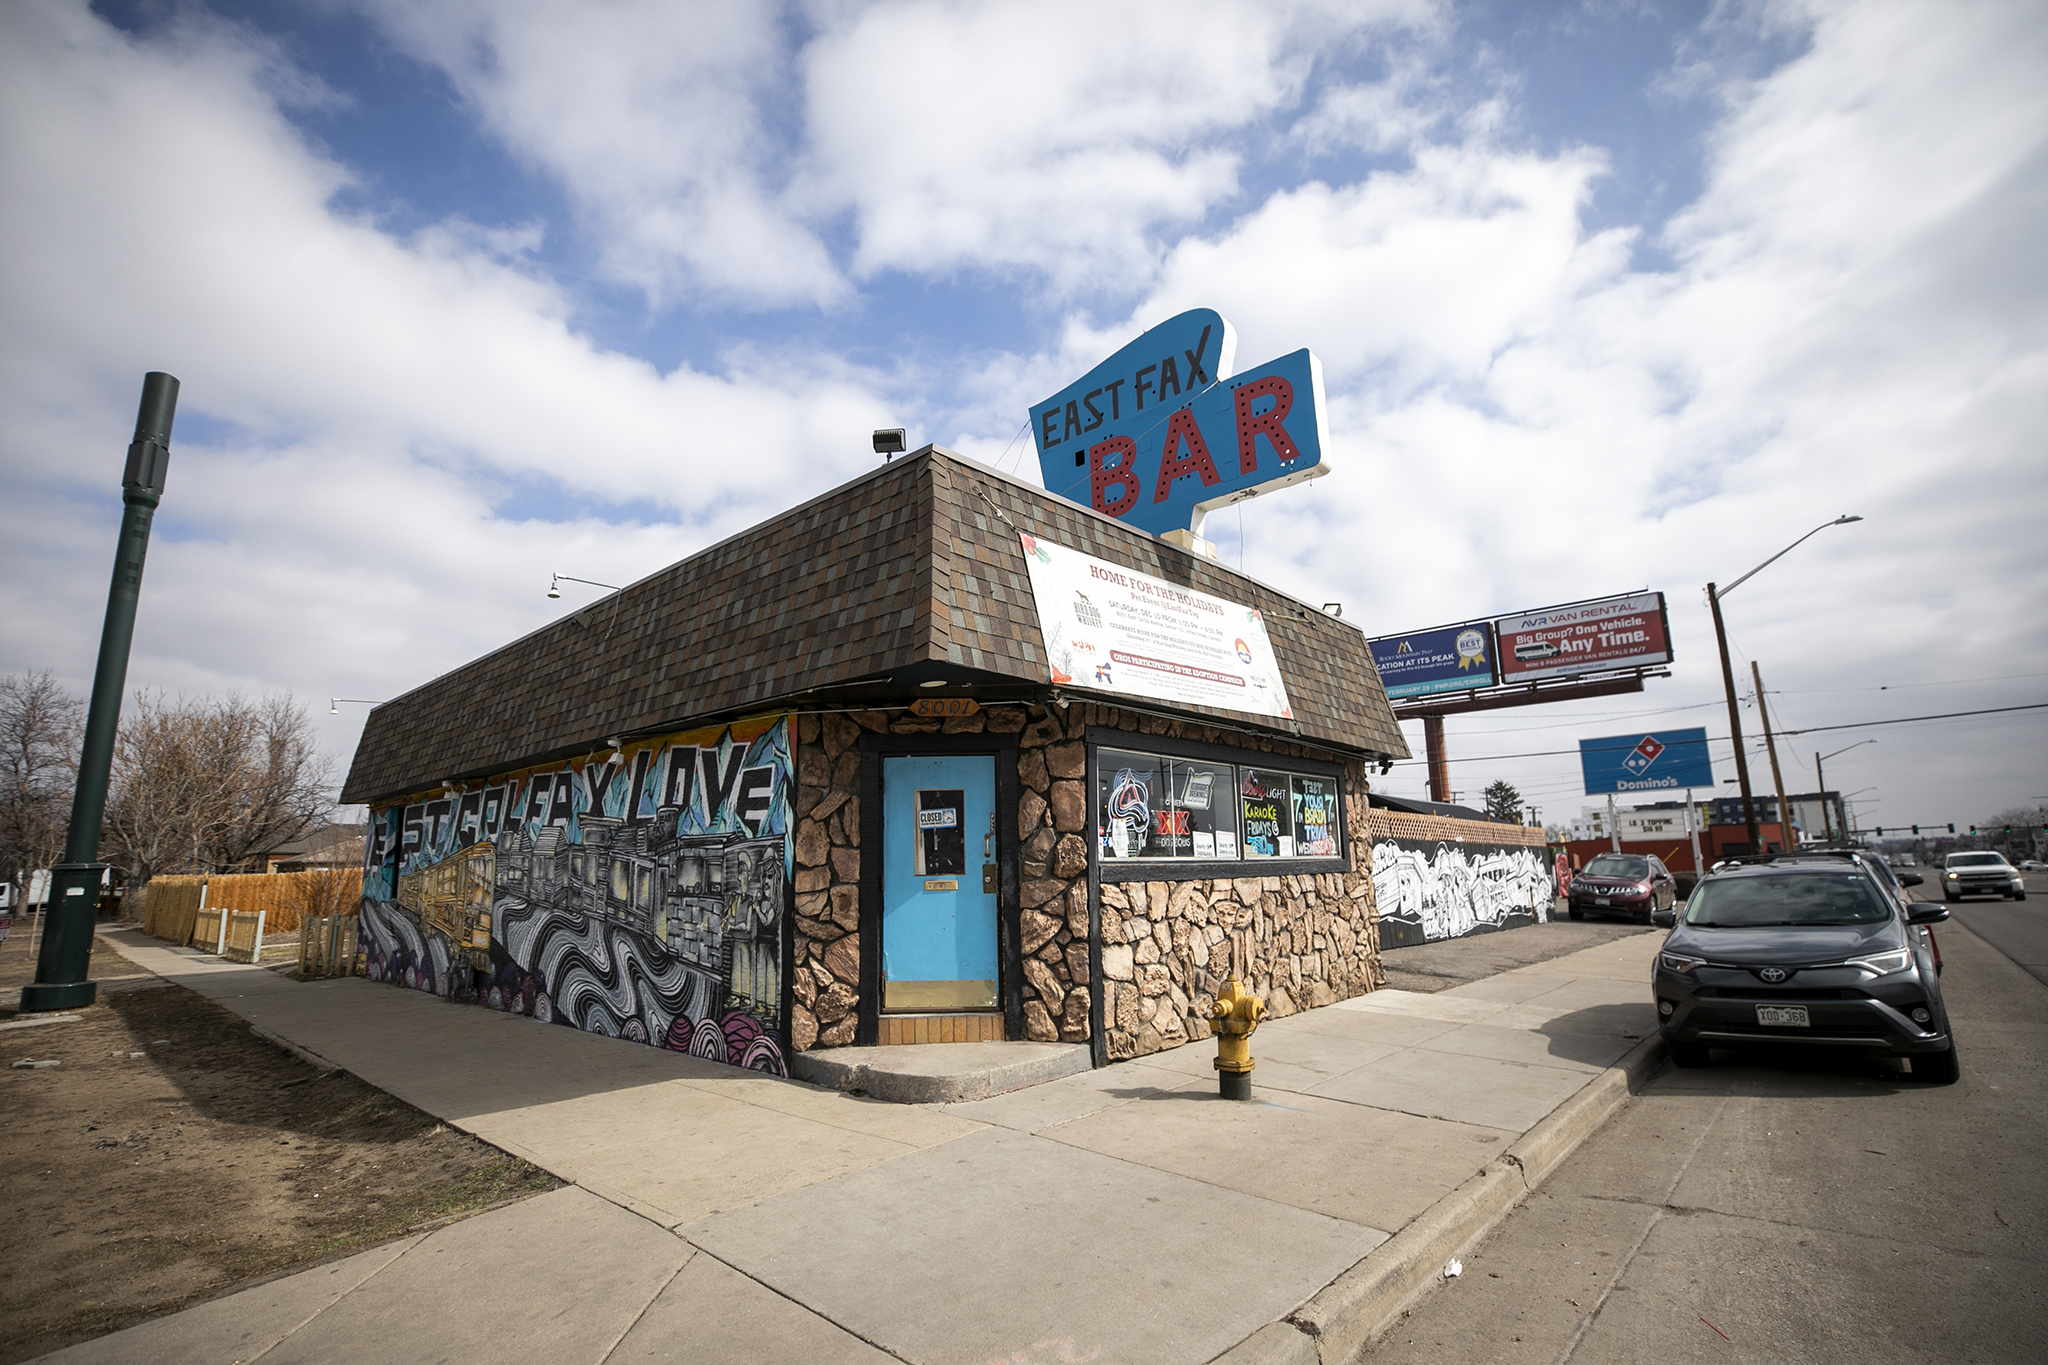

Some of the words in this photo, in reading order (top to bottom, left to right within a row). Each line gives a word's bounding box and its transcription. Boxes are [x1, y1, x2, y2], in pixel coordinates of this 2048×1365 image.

[1042, 379, 1125, 451] EAST
[1135, 324, 1212, 411] FAX
[1089, 375, 1301, 518] BAR
[1090, 564, 1128, 587] HOME
[1129, 576, 1153, 594] FOR
[1154, 585, 1175, 601] THE
[1176, 592, 1224, 615] HOLIDAYS
[1131, 592, 1142, 601] Pet
[1142, 595, 1160, 606] Event
[1521, 617, 1547, 629] AVR
[1549, 612, 1577, 624] VAN
[1580, 603, 1638, 619] RENTAL
[1516, 634, 1533, 645] Big
[1535, 628, 1573, 643] Group?
[1576, 624, 1598, 635] One
[1599, 616, 1646, 631] Vehicle.
[1460, 640, 1481, 649] BEST
[1559, 638, 1594, 653] Any
[1597, 629, 1650, 648] Time.
[1114, 653, 1131, 662] ORGS
[1132, 657, 1174, 671] PARTICIPATING
[1193, 669, 1218, 680] ADOPTION
[1405, 658, 1415, 668] AT
[1417, 656, 1430, 665] ITS
[1431, 653, 1455, 663] PEAK
[1525, 661, 1539, 669] MINI
[1545, 655, 1583, 667] PASSENGER
[1584, 653, 1597, 661] VAN
[1598, 649, 1627, 659] RENTALS
[1388, 684, 1421, 696] FEBRUARY
[1422, 683, 1430, 691] 28
[1434, 676, 1492, 690] RMP.ORG/ENROLL
[918, 700, 970, 716] 8001
[624, 742, 777, 838] LOVE
[1243, 778, 1266, 797] Coors
[1266, 787, 1286, 800] LIGHT
[1302, 780, 1323, 794] TEST
[1617, 776, 1678, 790] Domino's
[1244, 801, 1277, 820] KARAOKE
[1303, 793, 1324, 810] YOUR
[920, 812, 942, 823] CLOSED
[1304, 807, 1326, 825] BRAIN
[1647, 818, 1673, 826] TOPPING
[1247, 820, 1272, 837] FRIDAYS
[1304, 824, 1329, 841] TRIVIA
